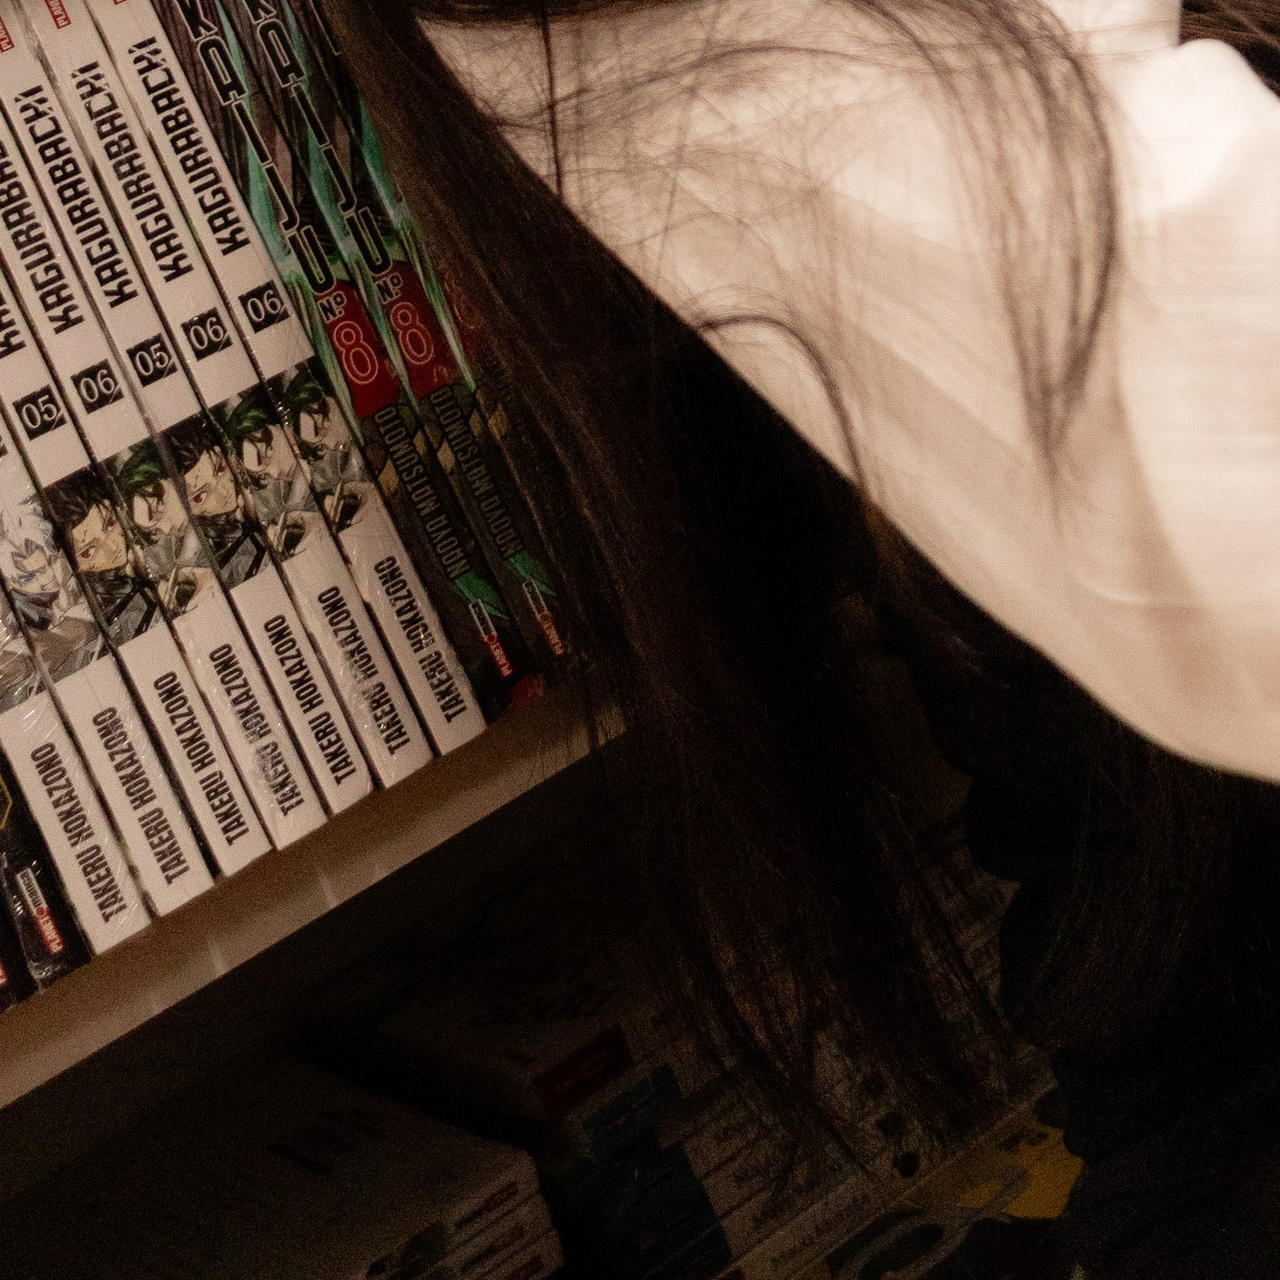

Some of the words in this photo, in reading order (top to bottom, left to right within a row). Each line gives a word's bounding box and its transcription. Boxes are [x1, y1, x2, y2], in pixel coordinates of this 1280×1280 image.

[71, 60, 195, 284] KAGURABACHI
[128, 36, 252, 257] KAGURABACHI
[14, 84, 139, 309] KAGURABACHI
[189, 316, 225, 351] 06
[246, 289, 282, 324] 06
[390, 301, 435, 366] 8
[78, 369, 115, 403] 06
[134, 342, 170, 377] 05
[333, 320, 379, 385] 8
[21, 394, 58, 430] 05
[317, 585, 379, 686] HOKAZONO
[374, 555, 437, 654] HOKAZONO
[208, 643, 273, 744] HOKAZONO
[263, 614, 327, 716] HOKAZONO
[418, 649, 468, 725] TAKERU
[152, 671, 218, 774] HOKAZONO
[308, 710, 358, 787] TAKERU
[361, 680, 412, 757] TAKERU
[92, 706, 158, 812] HOKAZONO
[138, 806, 191, 886] TAKERU
[199, 769, 251, 847] TAKERU
